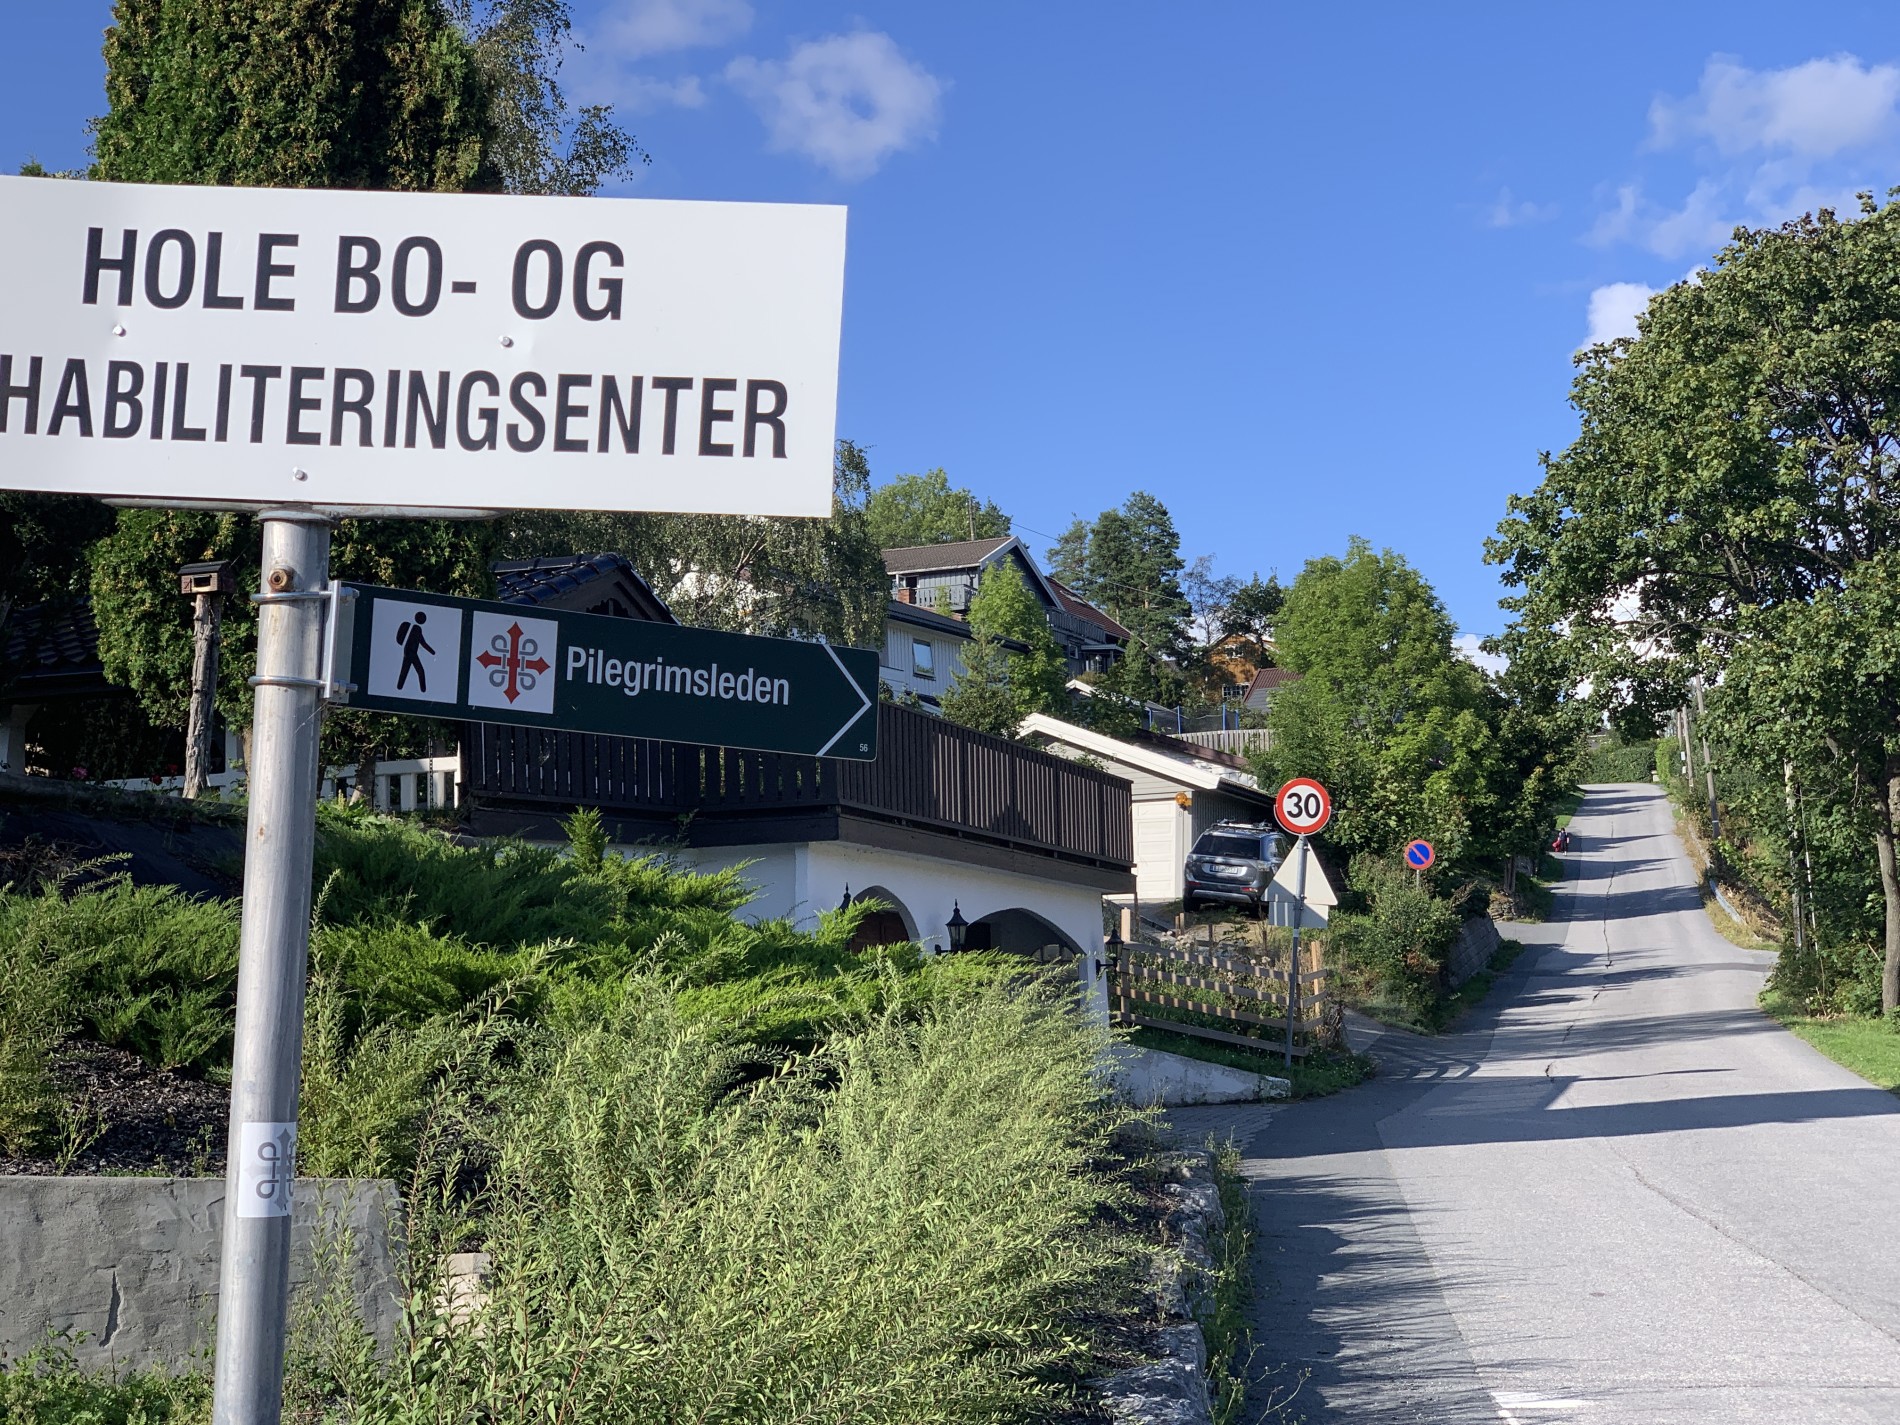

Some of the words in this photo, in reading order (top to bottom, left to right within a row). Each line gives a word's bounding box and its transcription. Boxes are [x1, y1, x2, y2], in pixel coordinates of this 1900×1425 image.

[83, 227, 299, 311] HOLE
[334, 235, 477, 317] BO-
[512, 239, 624, 321] OG
[0, 354, 788, 459] HABILITERINGSENTER
[566, 645, 790, 706] Pilegrimsleden
[859, 743, 869, 752] 56
[1286, 792, 1321, 819] 30
